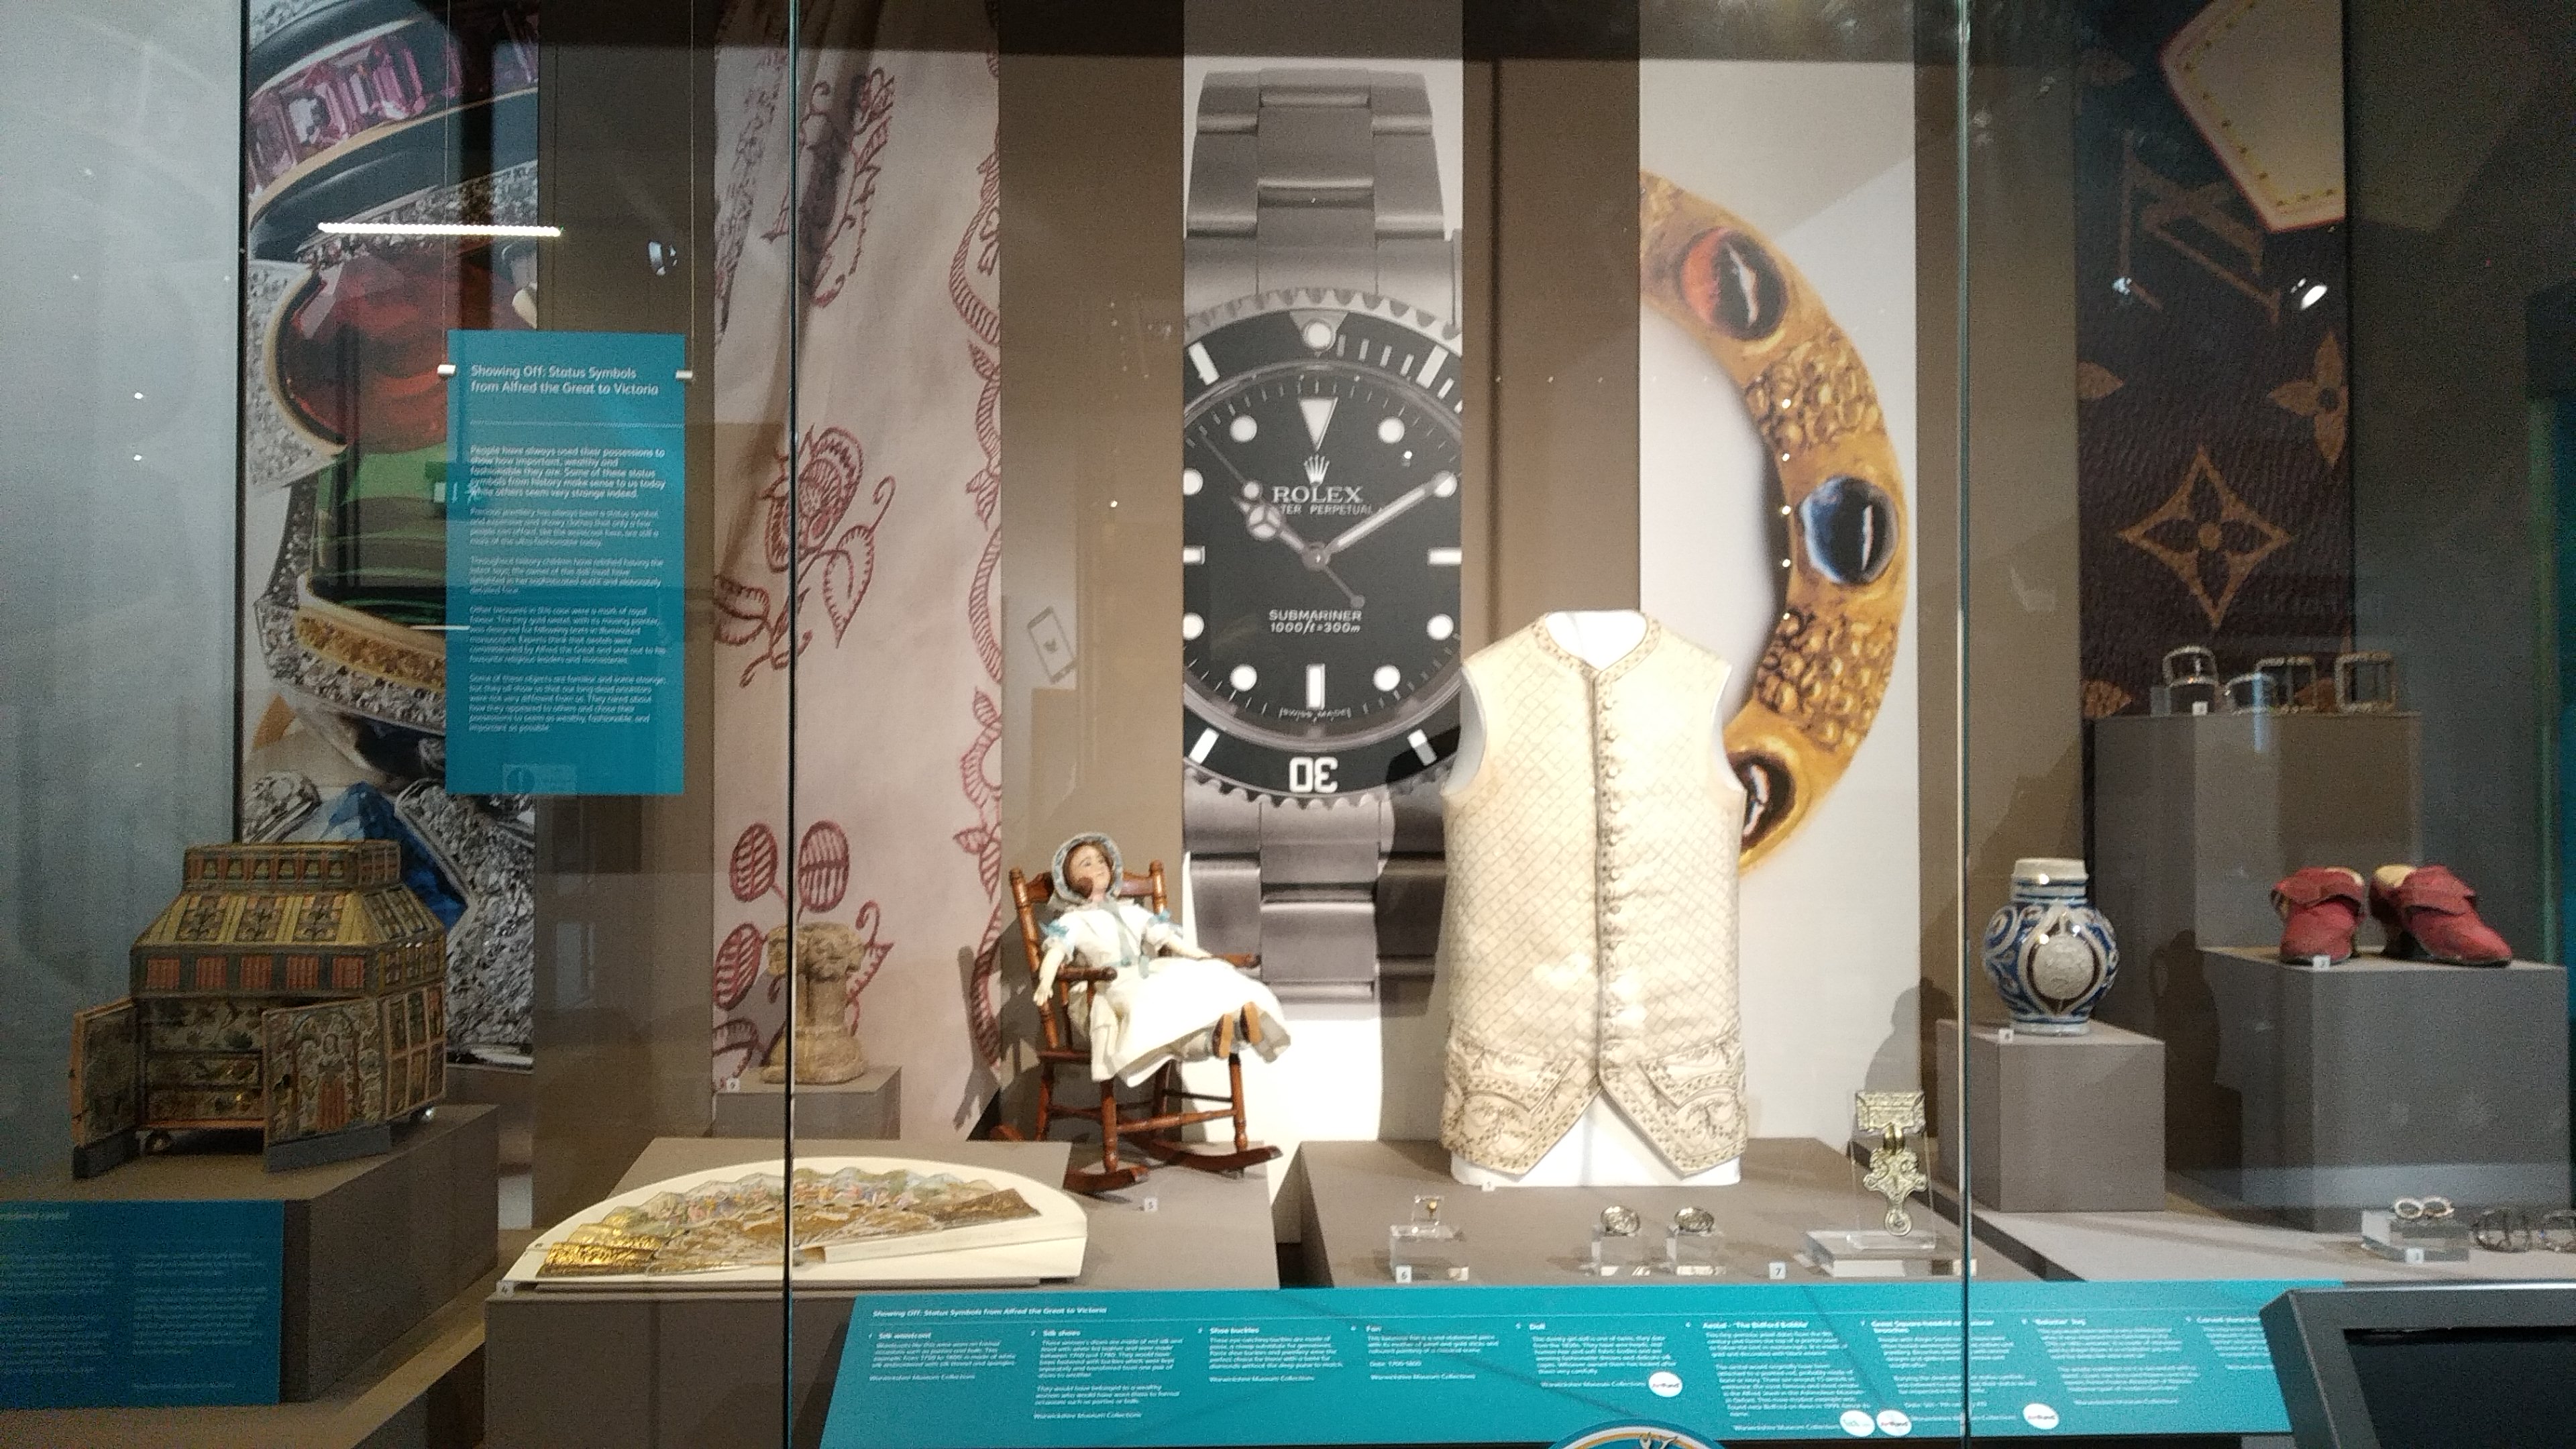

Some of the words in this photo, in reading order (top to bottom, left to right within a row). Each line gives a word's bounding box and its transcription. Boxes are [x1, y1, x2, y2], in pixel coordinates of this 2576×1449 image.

[471, 366, 520, 380] Showing
[548, 367, 586, 378] Status
[588, 368, 637, 382] Symbols
[471, 382, 498, 393] from
[501, 382, 537, 393] Alfred
[540, 382, 559, 394] the
[562, 383, 595, 394] Great
[598, 384, 610, 394] to
[613, 384, 659, 395] Victoria
[1272, 486, 1363, 504] ROLEX
[1269, 609, 1362, 622] SUBMARINER
[872, 1309, 906, 1318] Showing
[949, 1308, 981, 1317] Symbols
[1529, 1322, 1546, 1330] Doll
